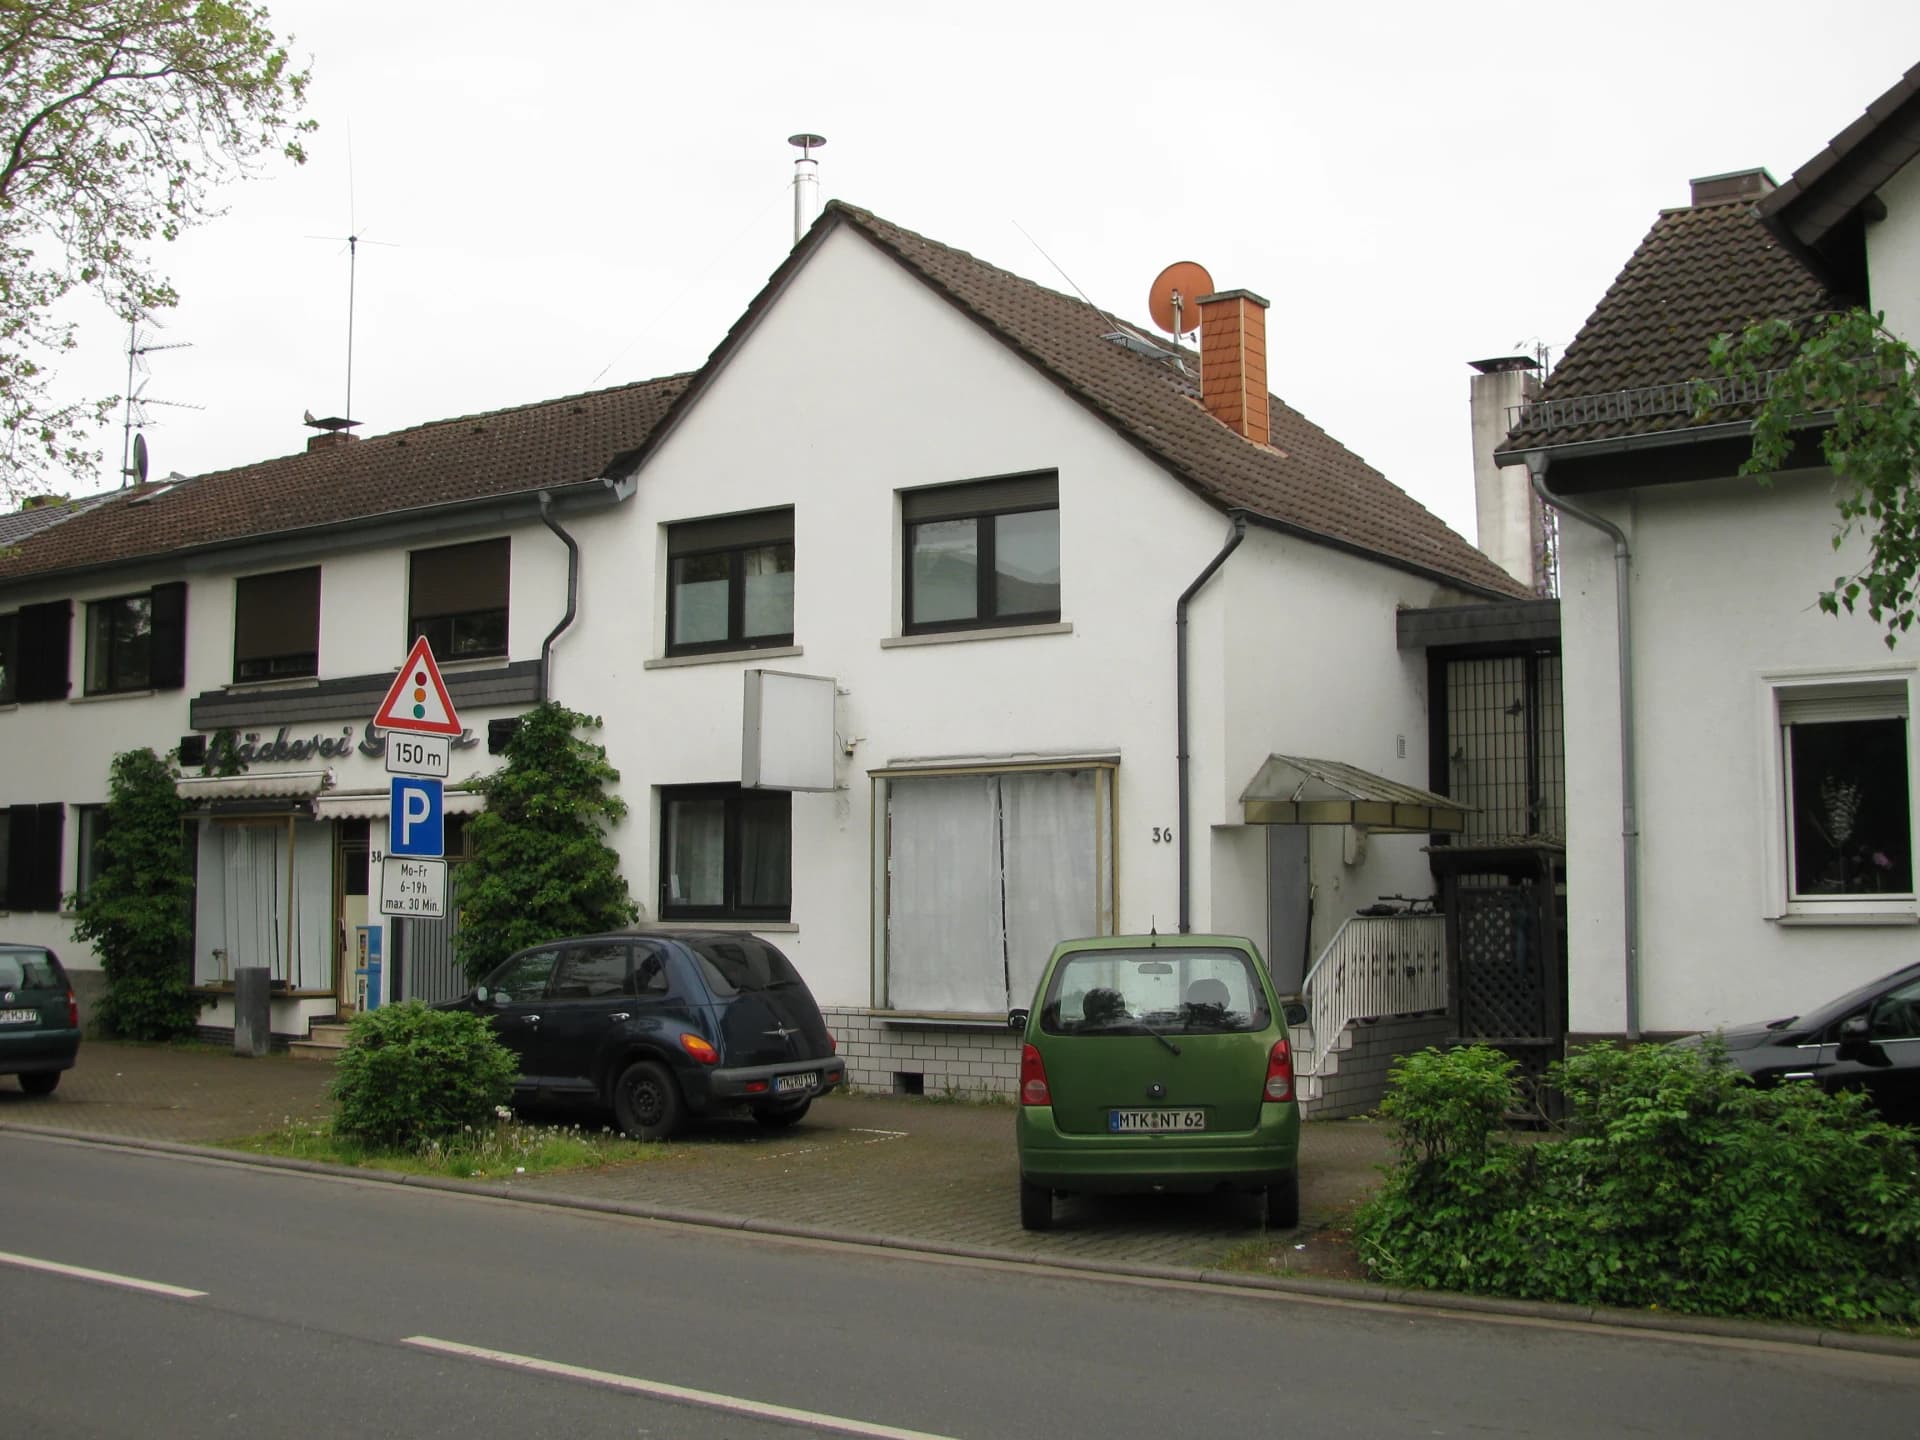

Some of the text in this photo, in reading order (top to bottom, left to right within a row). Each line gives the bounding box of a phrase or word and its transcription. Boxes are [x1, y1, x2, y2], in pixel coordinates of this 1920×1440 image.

[395, 742, 441, 767] 150 m
[402, 787, 431, 846] P
[1152, 826, 1172, 845] 36
[371, 850, 382, 863] 38
[400, 863, 428, 878] Mo-Fr
[400, 880, 428, 894] 6-19h
[385, 897, 440, 913] max. 30 Min.
[1119, 1112, 1204, 1129] MTK NT 62
